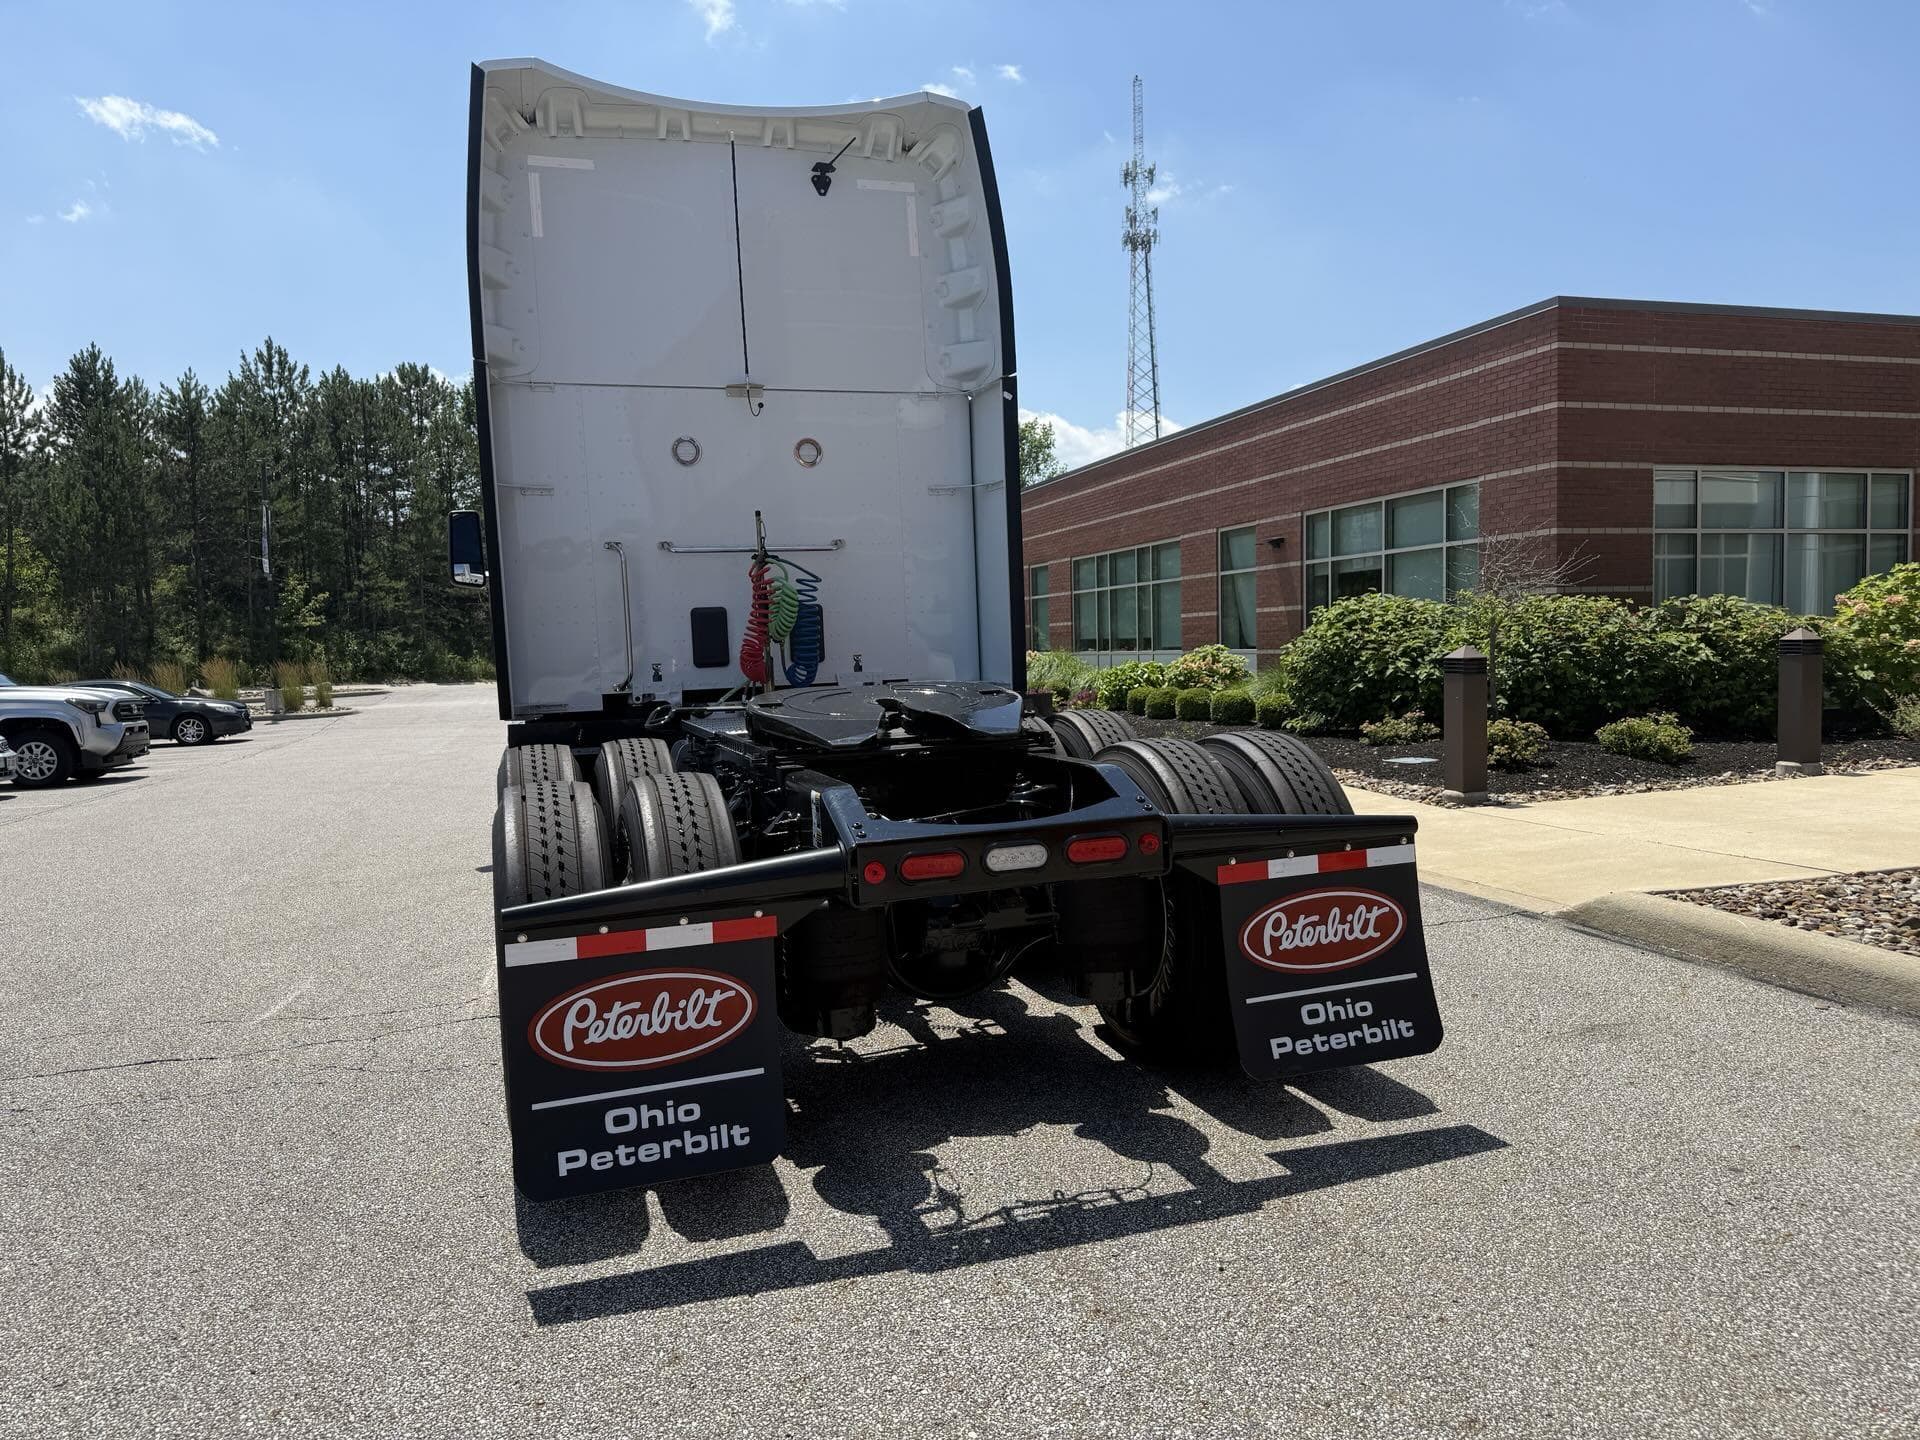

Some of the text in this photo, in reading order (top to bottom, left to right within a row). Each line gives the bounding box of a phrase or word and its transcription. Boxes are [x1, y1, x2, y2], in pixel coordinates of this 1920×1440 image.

[1264, 905, 1390, 956] Peterbilt
[564, 989, 736, 1052] Peterbilt
[1301, 999, 1373, 1025] Ohio
[1270, 1019, 1415, 1060] Peterbilt
[604, 1101, 701, 1134] Ohio
[557, 1124, 750, 1177] Peterbilt
